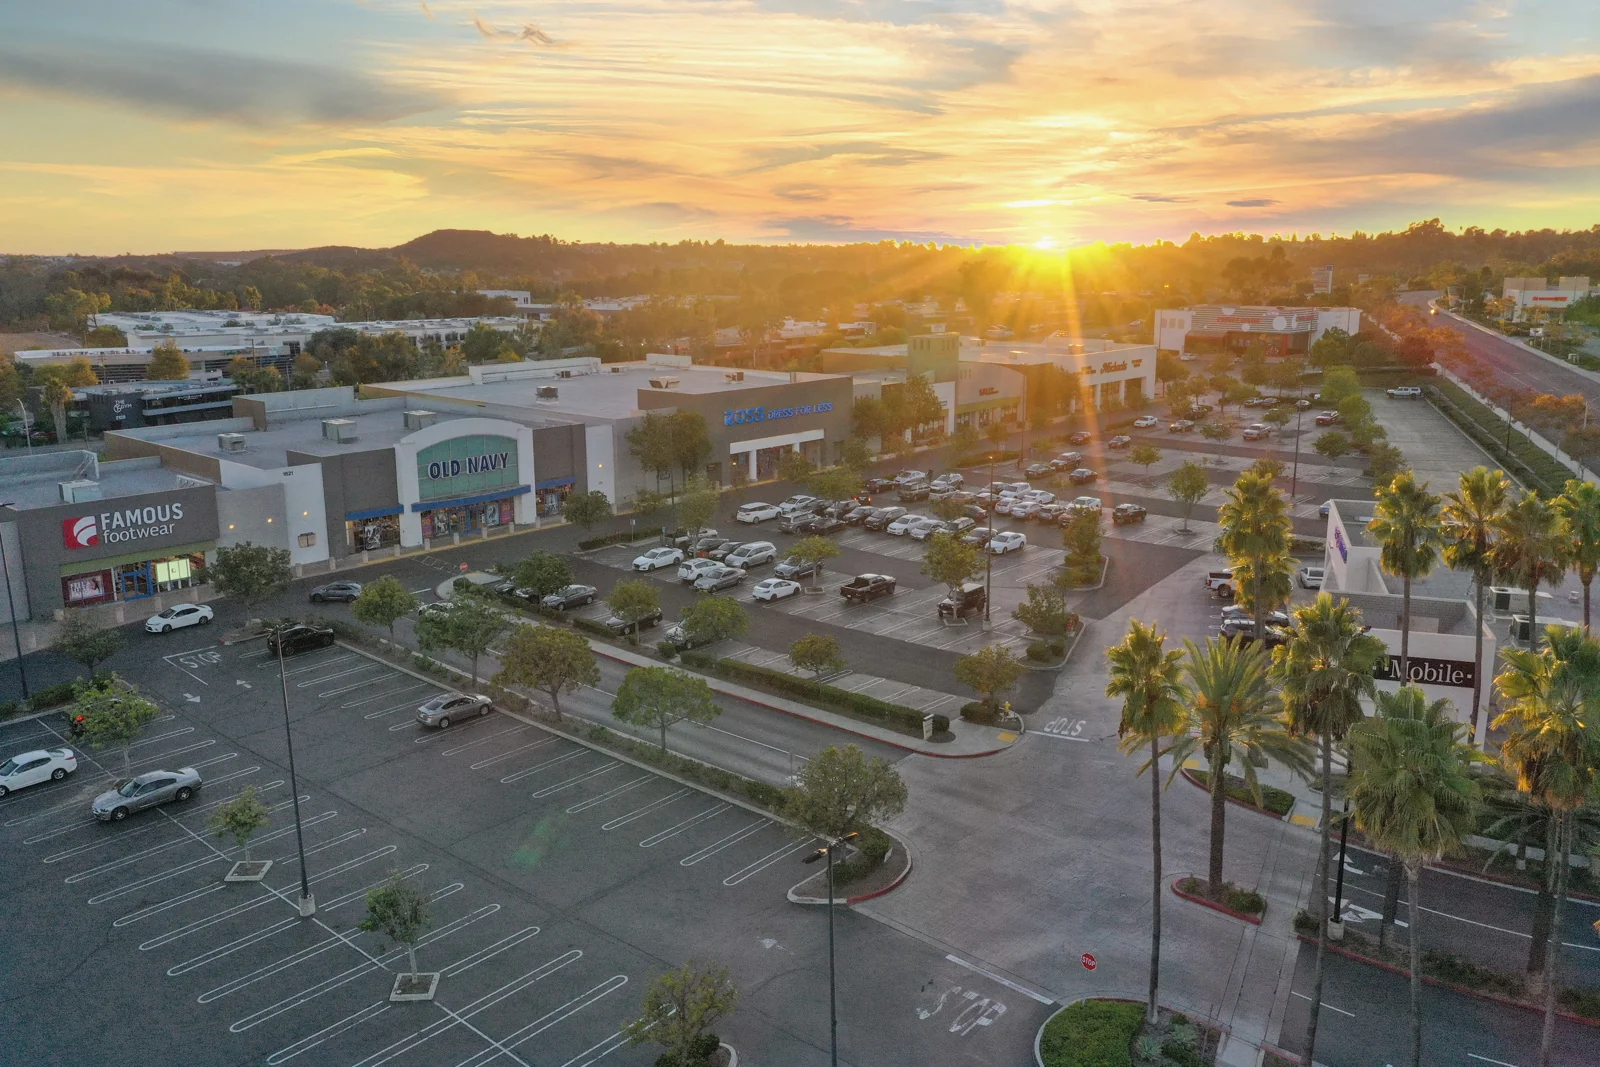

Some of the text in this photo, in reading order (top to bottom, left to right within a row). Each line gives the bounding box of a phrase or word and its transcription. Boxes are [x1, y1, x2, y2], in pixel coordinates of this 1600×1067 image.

[724, 402, 834, 426] ROSS DRESS FOR LESS
[428, 452, 509, 480] OLD NAVY
[100, 502, 184, 531] FAMOUS
[103, 523, 176, 544] footwear
[179, 651, 222, 669] STOP
[1043, 716, 1087, 736] STOP
[1082, 955, 1096, 967] STOP
